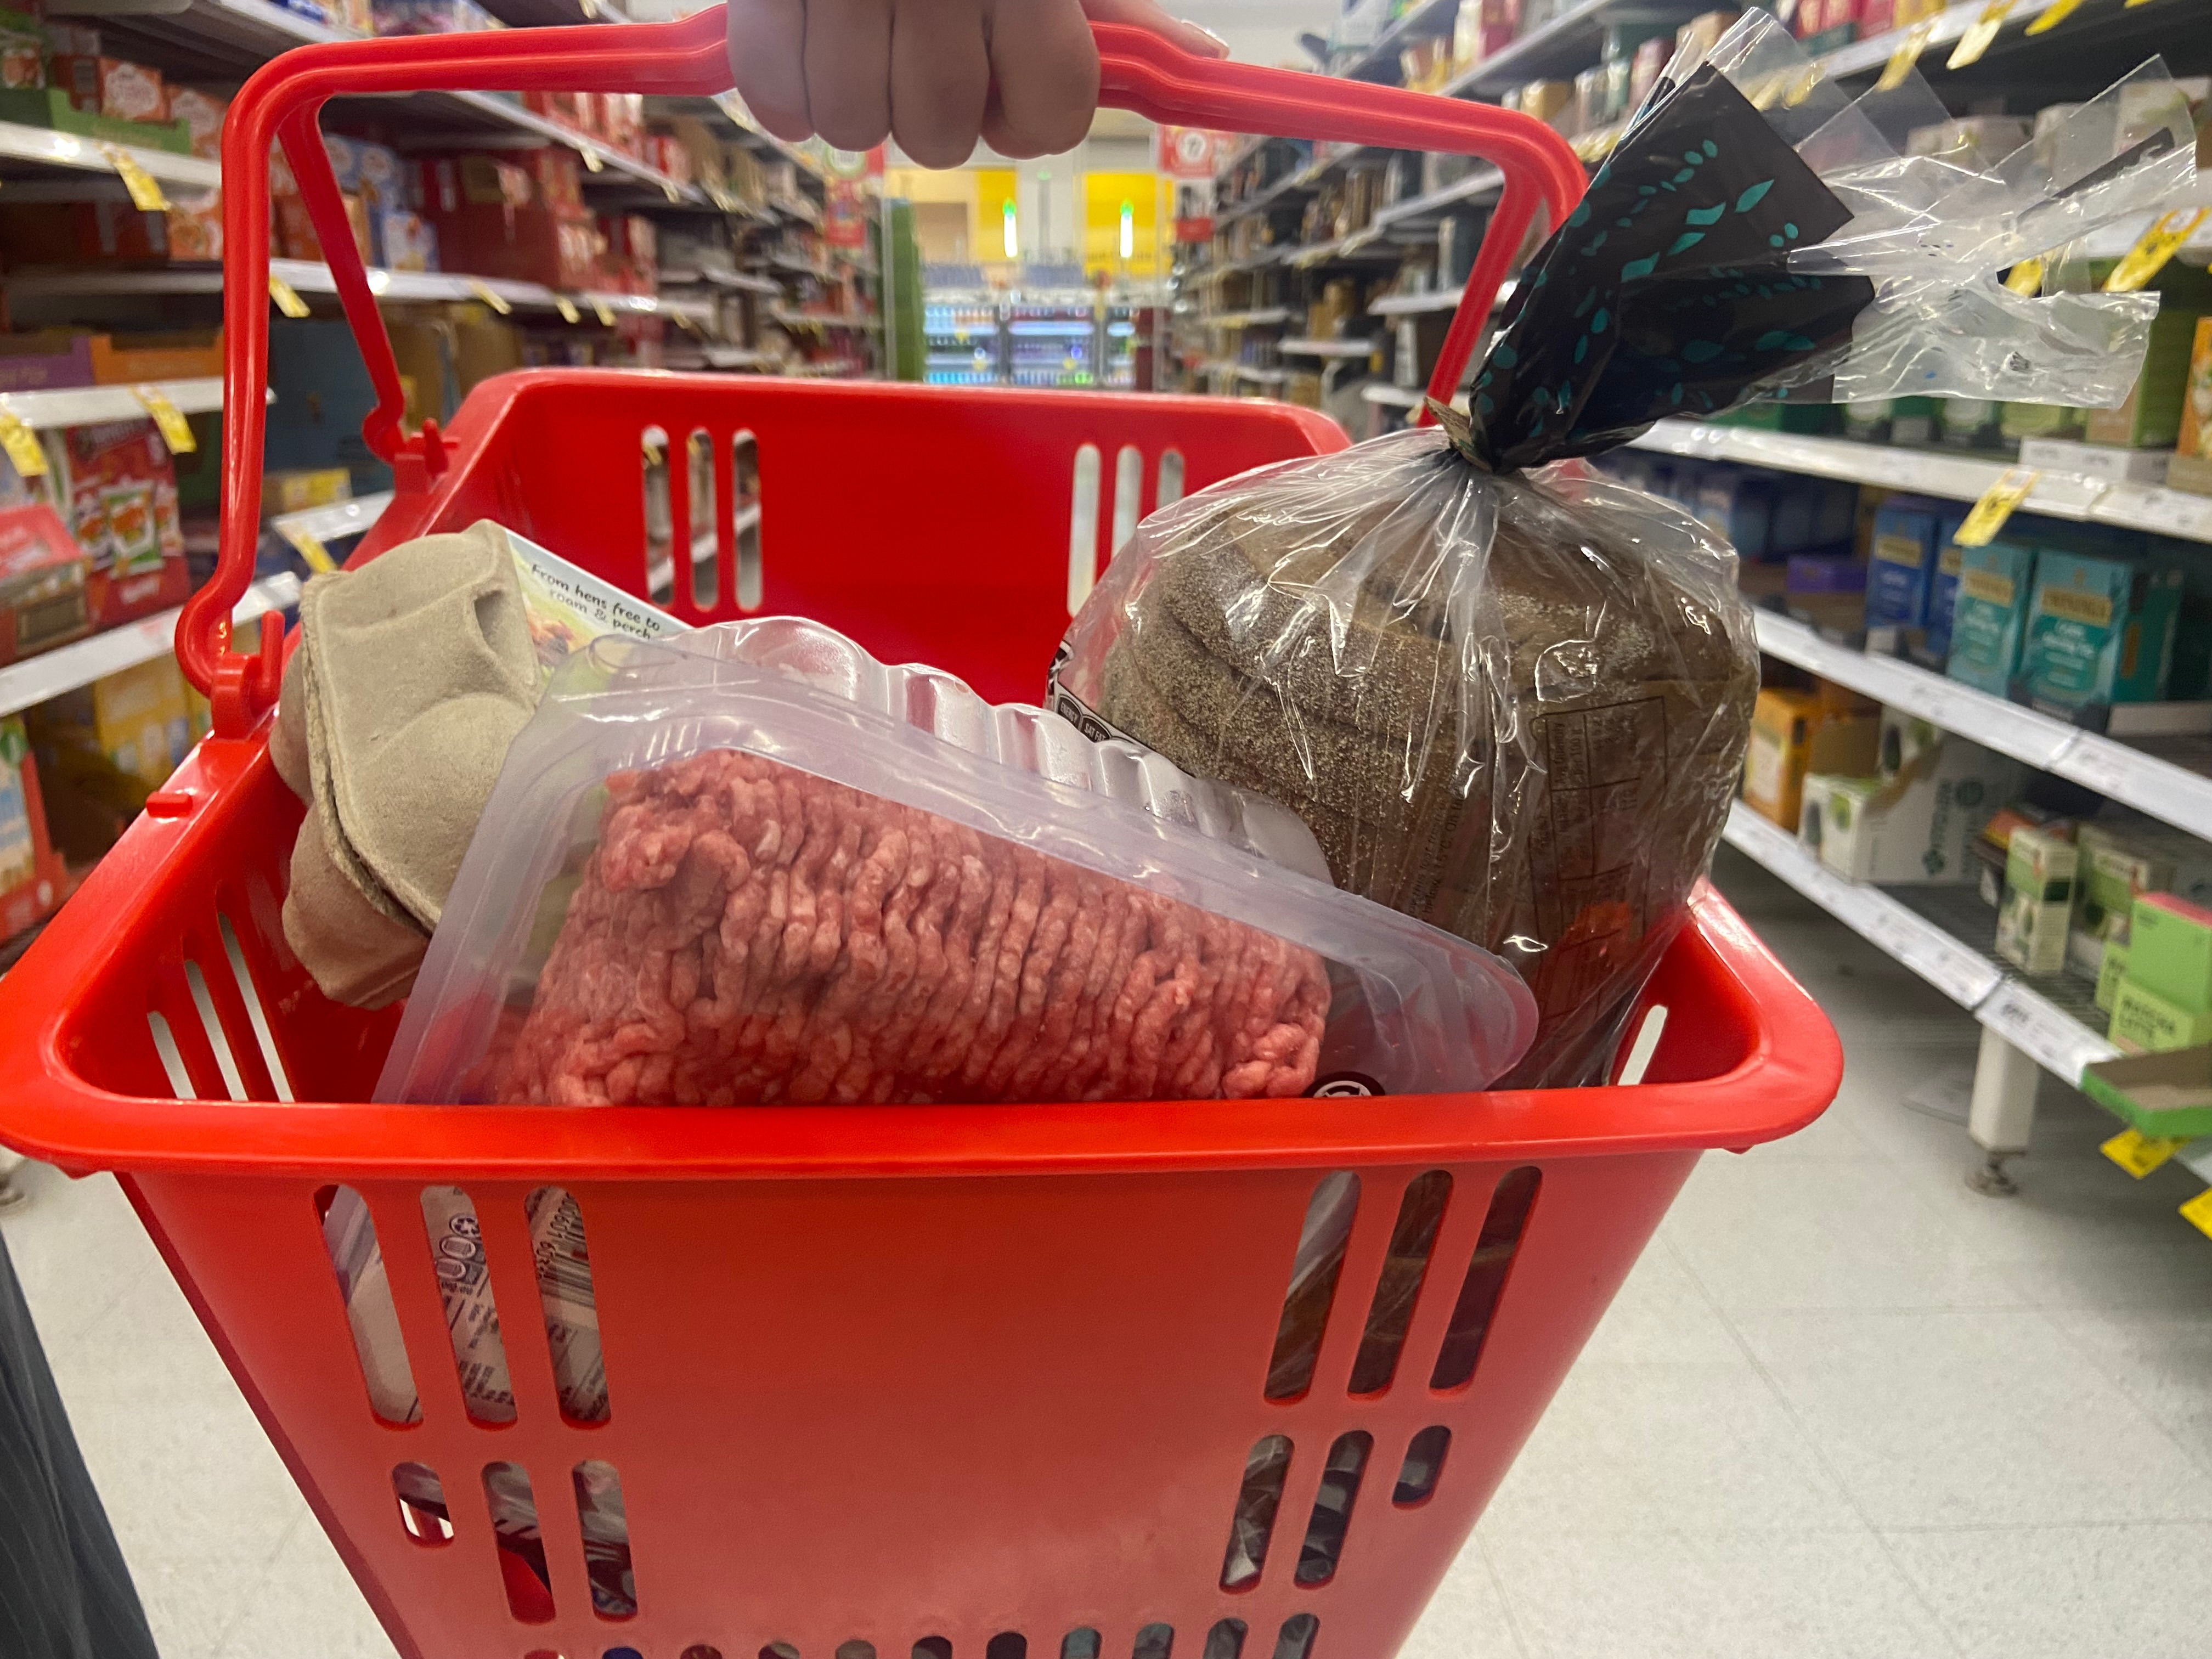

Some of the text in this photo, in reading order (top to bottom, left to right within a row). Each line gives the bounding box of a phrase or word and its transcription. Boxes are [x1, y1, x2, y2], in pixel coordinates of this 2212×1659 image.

[532, 563, 661, 631] From hens free to
[550, 589, 651, 640] roam & perch
[1060, 702, 1079, 724] ENERGY
[1084, 723, 1107, 742] SAT FAT
[1444, 814, 1460, 832] On
